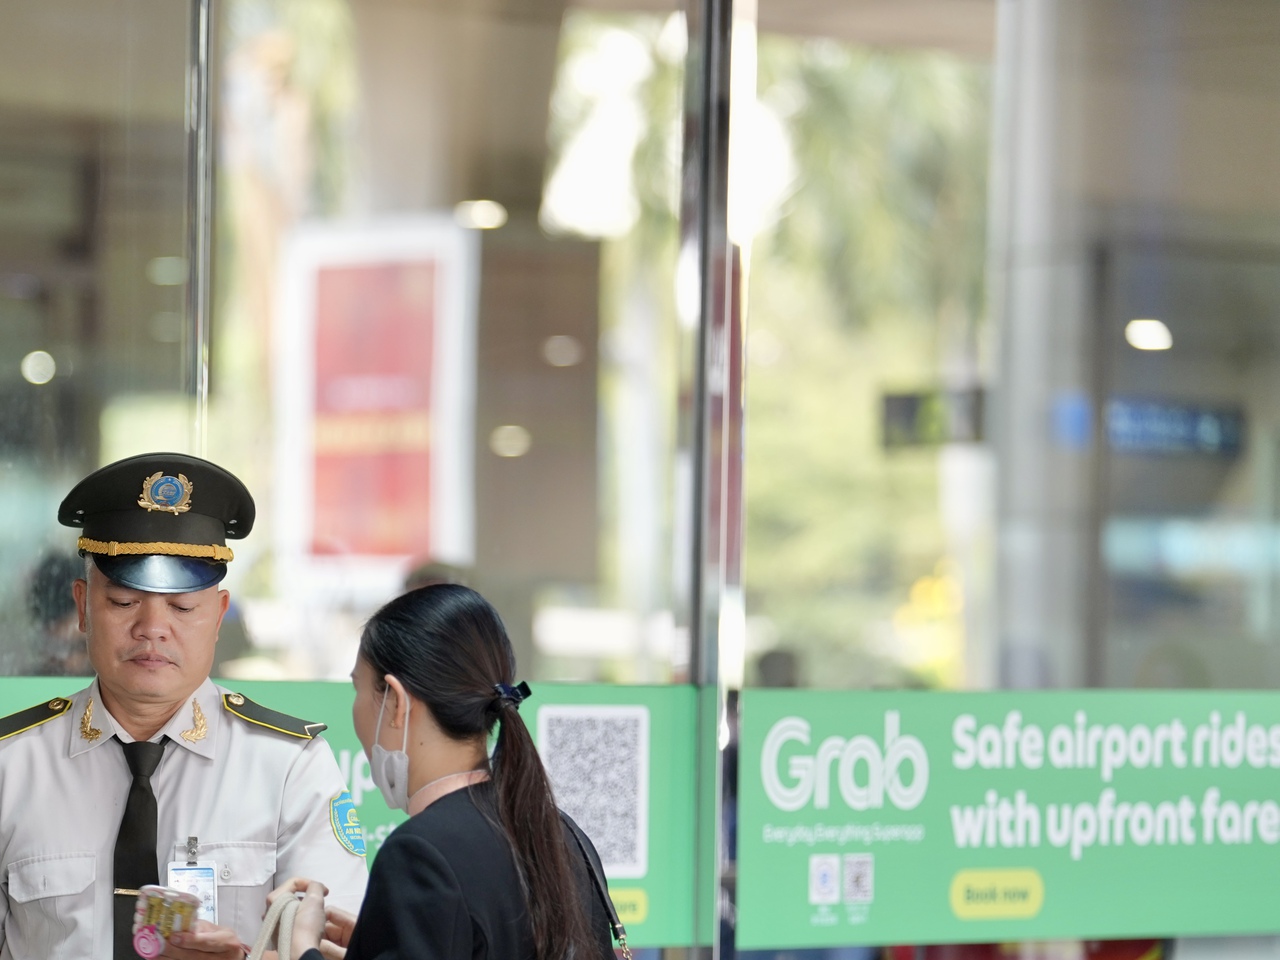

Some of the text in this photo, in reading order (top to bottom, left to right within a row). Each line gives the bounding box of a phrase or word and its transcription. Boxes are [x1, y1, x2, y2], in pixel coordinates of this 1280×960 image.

[760, 709, 929, 812] Grab
[951, 709, 1045, 770] Safe
[1047, 709, 1188, 783] airport
[949, 786, 1280, 861] with upfront fare
[963, 883, 1029, 905] Book now
